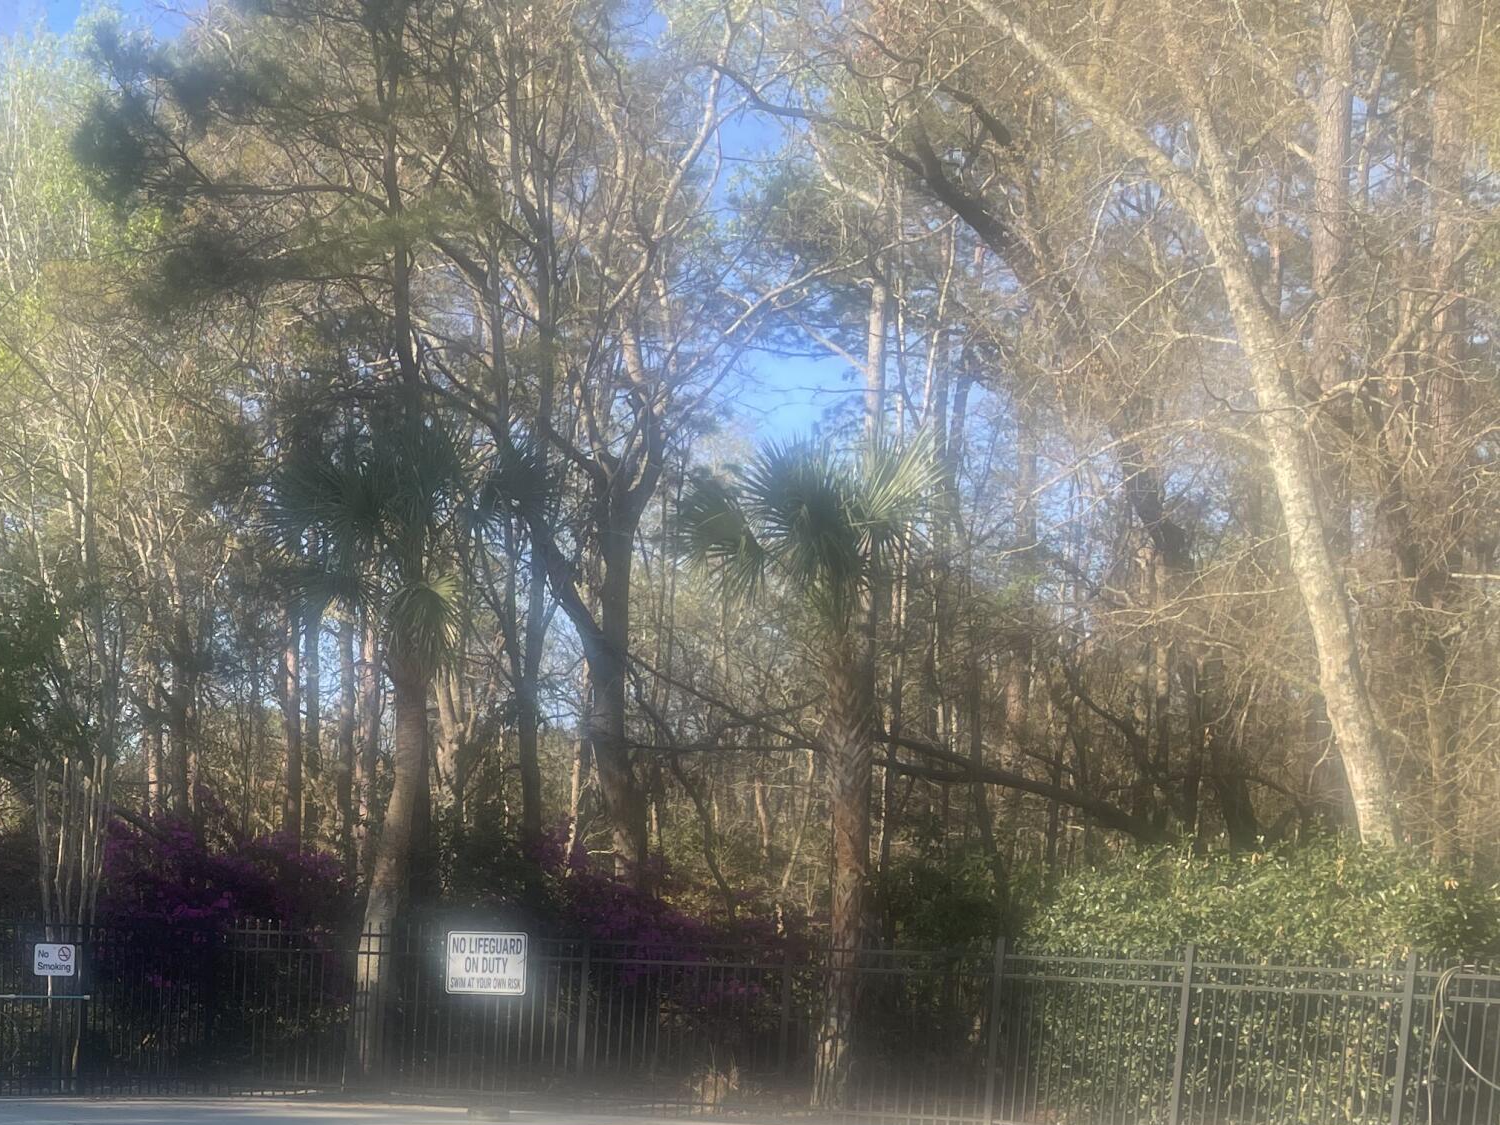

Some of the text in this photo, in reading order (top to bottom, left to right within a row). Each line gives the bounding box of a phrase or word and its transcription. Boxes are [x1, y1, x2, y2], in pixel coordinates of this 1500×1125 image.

[452, 936, 523, 955] NO LIFEGUARD
[38, 949, 50, 959] No
[38, 962, 72, 974] Smoking
[465, 956, 509, 974] ON DUTY
[467, 977, 475, 988] AT
[476, 977, 491, 989] YOUR
